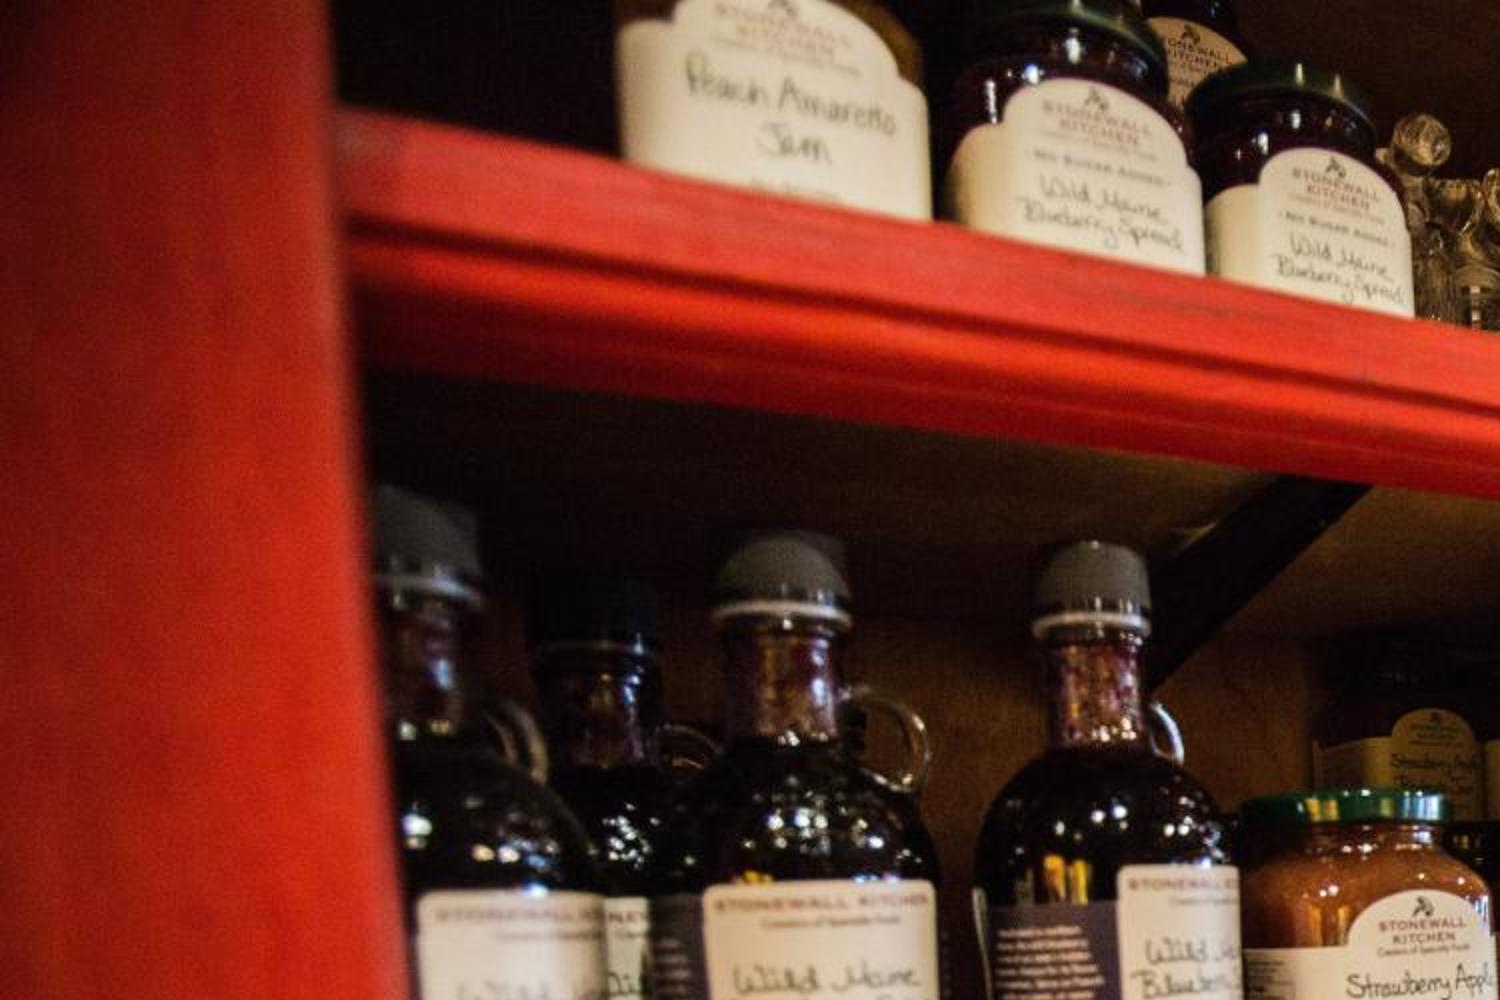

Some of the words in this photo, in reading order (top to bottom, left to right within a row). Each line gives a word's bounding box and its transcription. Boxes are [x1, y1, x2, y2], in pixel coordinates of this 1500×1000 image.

[753, 121, 833, 164] Jam
[1377, 915, 1467, 933] STONEWALL
[1391, 930, 1457, 945] KITCHEN
[1144, 936, 1209, 966] Wild
[732, 962, 822, 996] Wild
